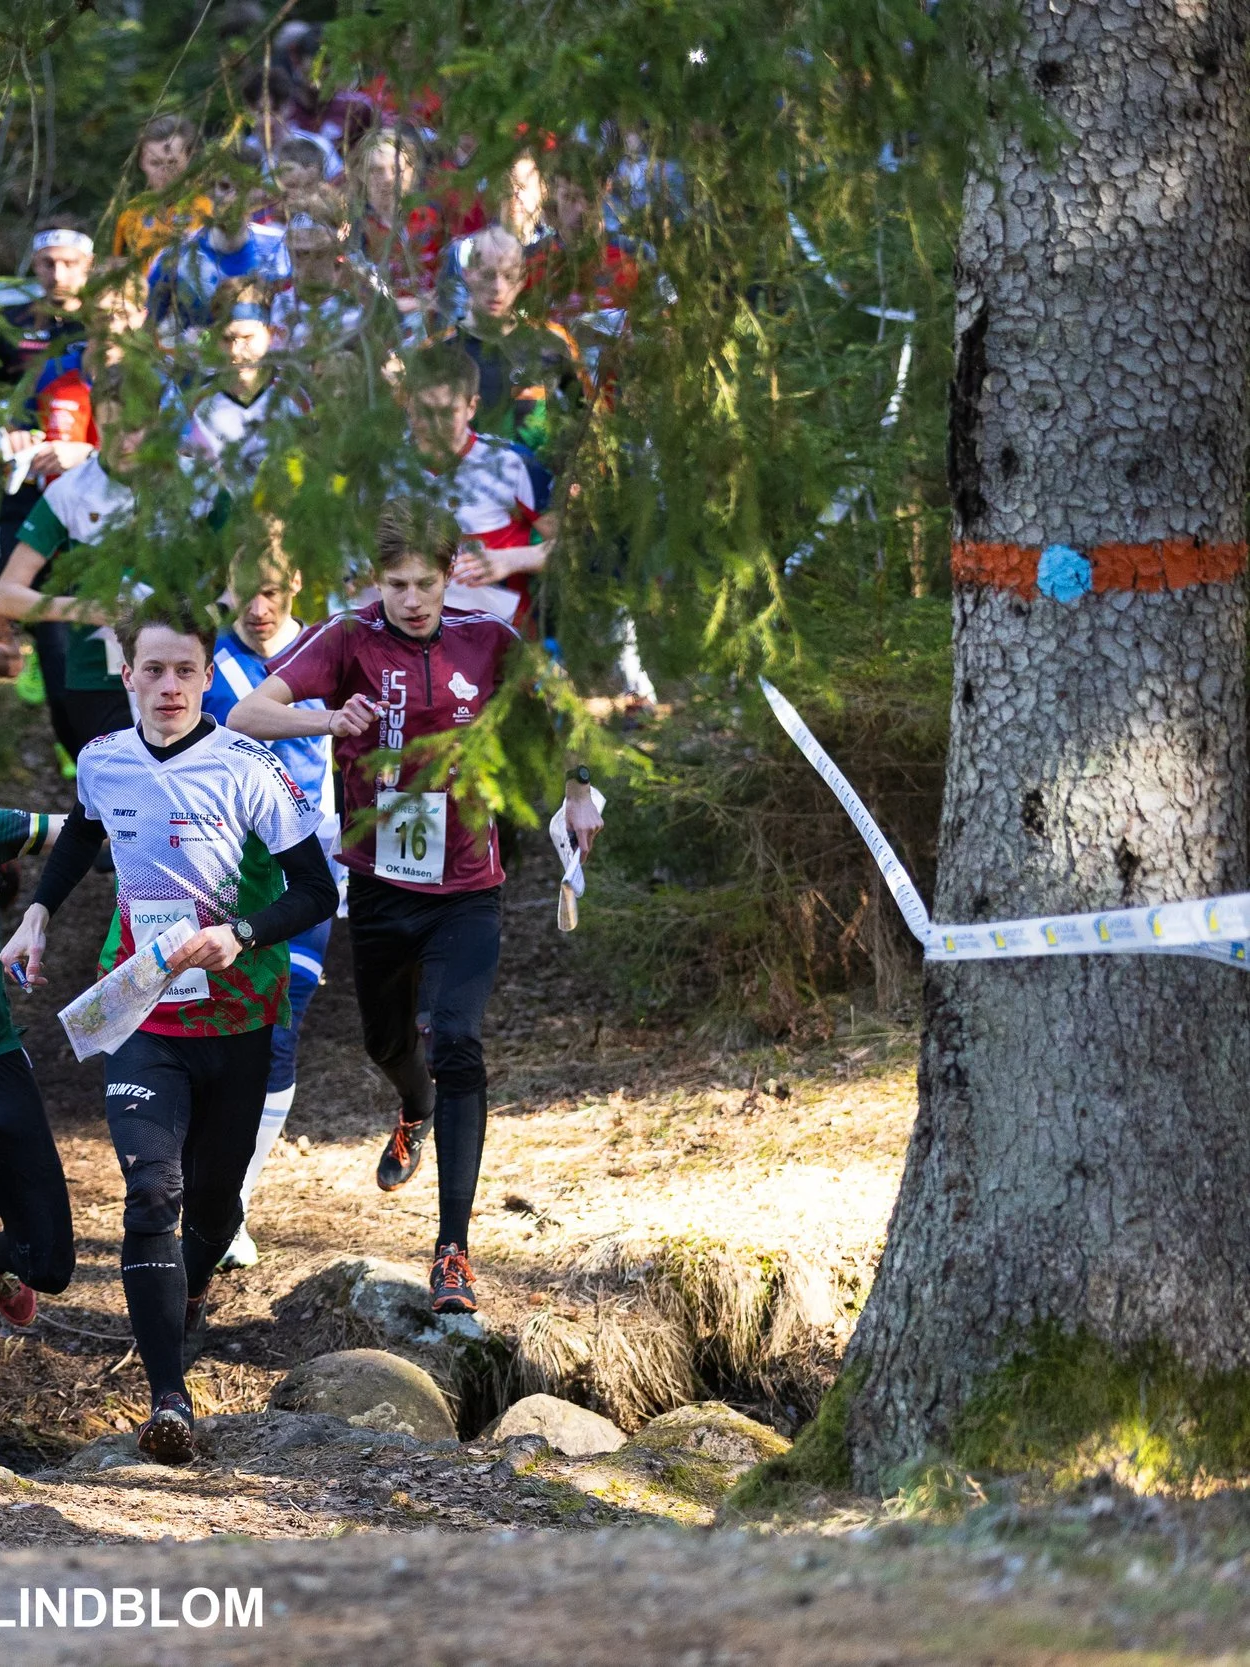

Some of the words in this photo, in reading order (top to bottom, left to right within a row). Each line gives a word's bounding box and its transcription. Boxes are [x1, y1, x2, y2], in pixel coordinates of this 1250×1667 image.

[395, 821, 427, 862] 16
[386, 864, 400, 874] OK
[402, 866, 432, 878] Måsen
[134, 913, 173, 924] NOREX
[165, 986, 197, 996] Måsen
[106, 1083, 156, 1101] TRIMTEX
